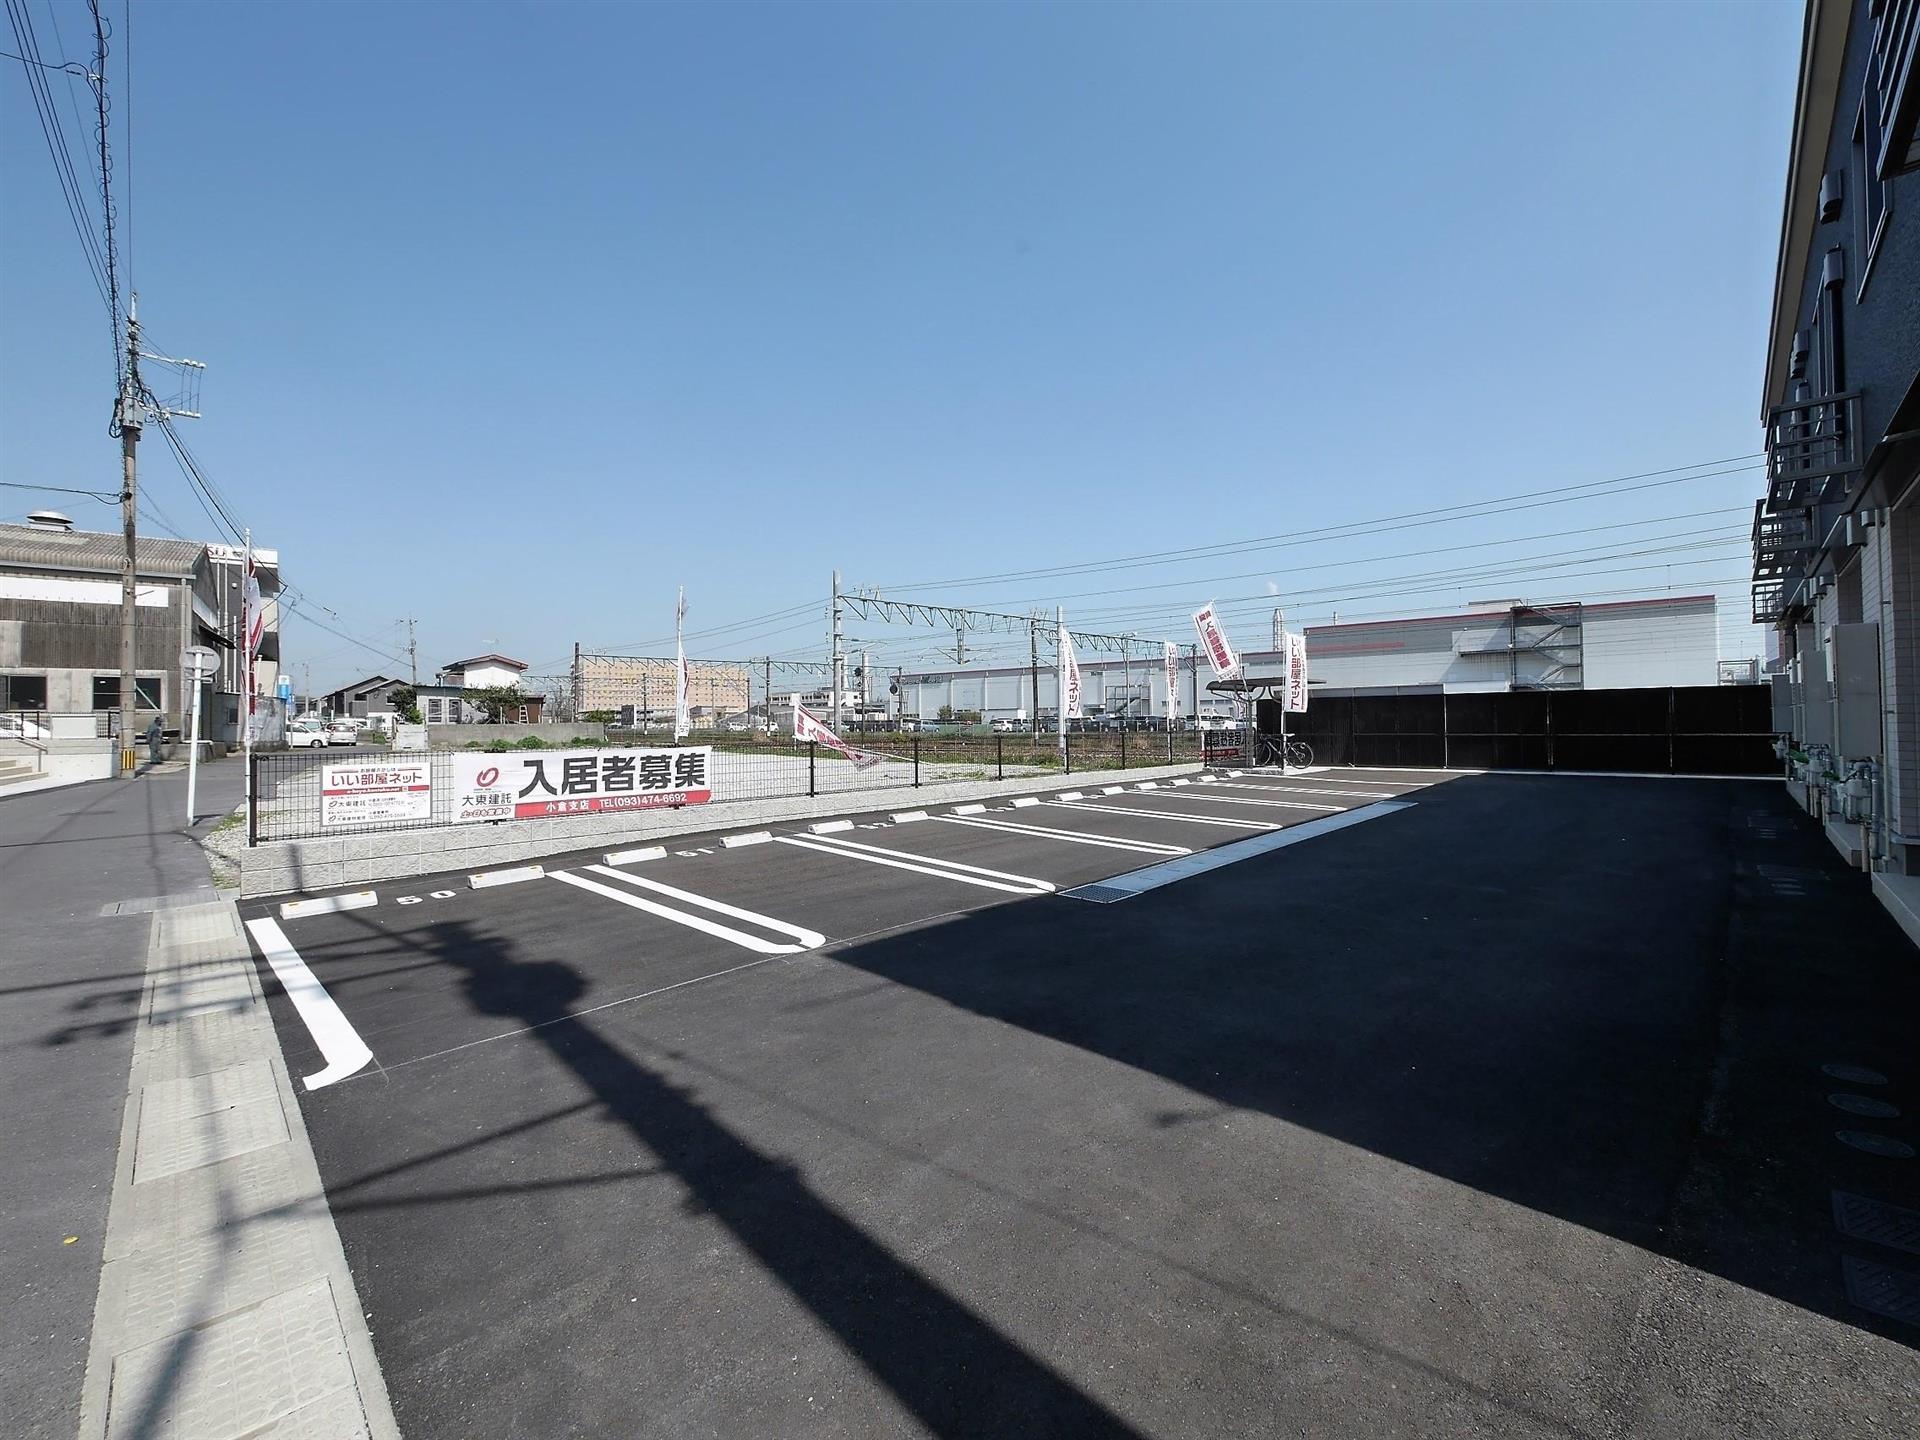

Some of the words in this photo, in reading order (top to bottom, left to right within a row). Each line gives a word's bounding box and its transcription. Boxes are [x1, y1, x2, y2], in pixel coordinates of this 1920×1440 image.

[331, 771, 423, 787] いい部屋ネット
[518, 752, 706, 799] 入居者募集
[461, 792, 512, 807] 大東建託
[545, 799, 590, 813] 小倉支店
[599, 792, 688, 809] TEL(093)474-6692
[395, 890, 457, 905] 50
